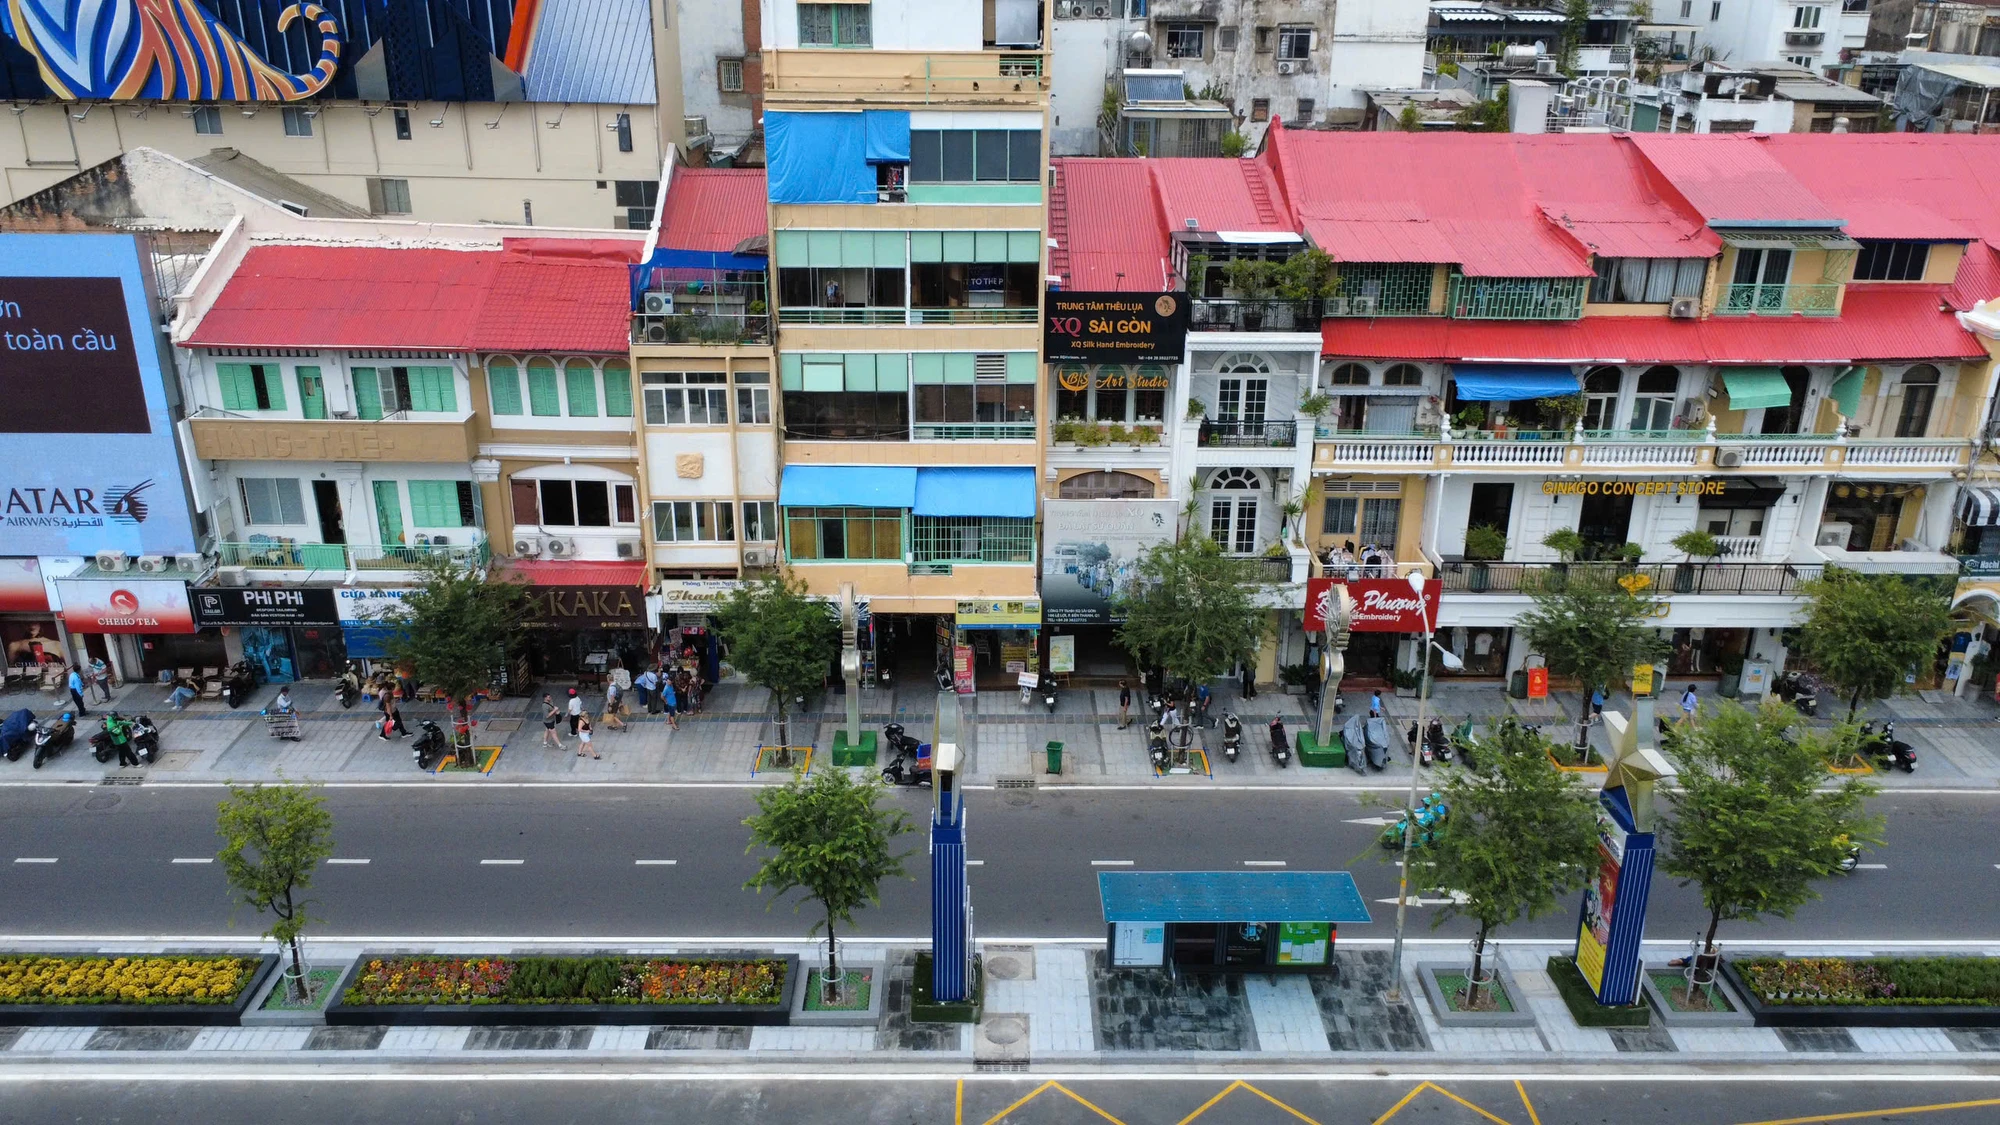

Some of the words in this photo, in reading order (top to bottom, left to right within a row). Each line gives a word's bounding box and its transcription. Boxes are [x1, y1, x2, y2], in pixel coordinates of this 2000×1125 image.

[970, 278, 982, 286] TO
[1056, 302, 1084, 311] TRUNG
[1086, 301, 1104, 311] TÂM
[1105, 301, 1126, 311] THÊU
[1127, 302, 1144, 314] LỤA
[1050, 317, 1082, 337] XQ
[1088, 317, 1113, 334] SÀI
[1116, 317, 1151, 334] GÒN
[4, 328, 64, 351] toàn
[72, 327, 117, 351] cầu
[1116, 340, 1155, 350] Embroidery
[1095, 374, 1124, 388] Art
[1126, 373, 1168, 389] Studio
[1542, 482, 1598, 495] GINKGO
[1603, 482, 1672, 495] CONCEPT
[1677, 482, 1726, 495] STORE
[0, 487, 100, 520] ATAR
[1127, 508, 1145, 519] XQ
[6, 516, 60, 527] AIRWAYS
[62, 518, 104, 528] القطرية
[549, 591, 638, 616] KAKA
[98, 618, 136, 626] CHEHO
[136, 618, 158, 626] TEA
[1360, 614, 1401, 622] Embroidery
